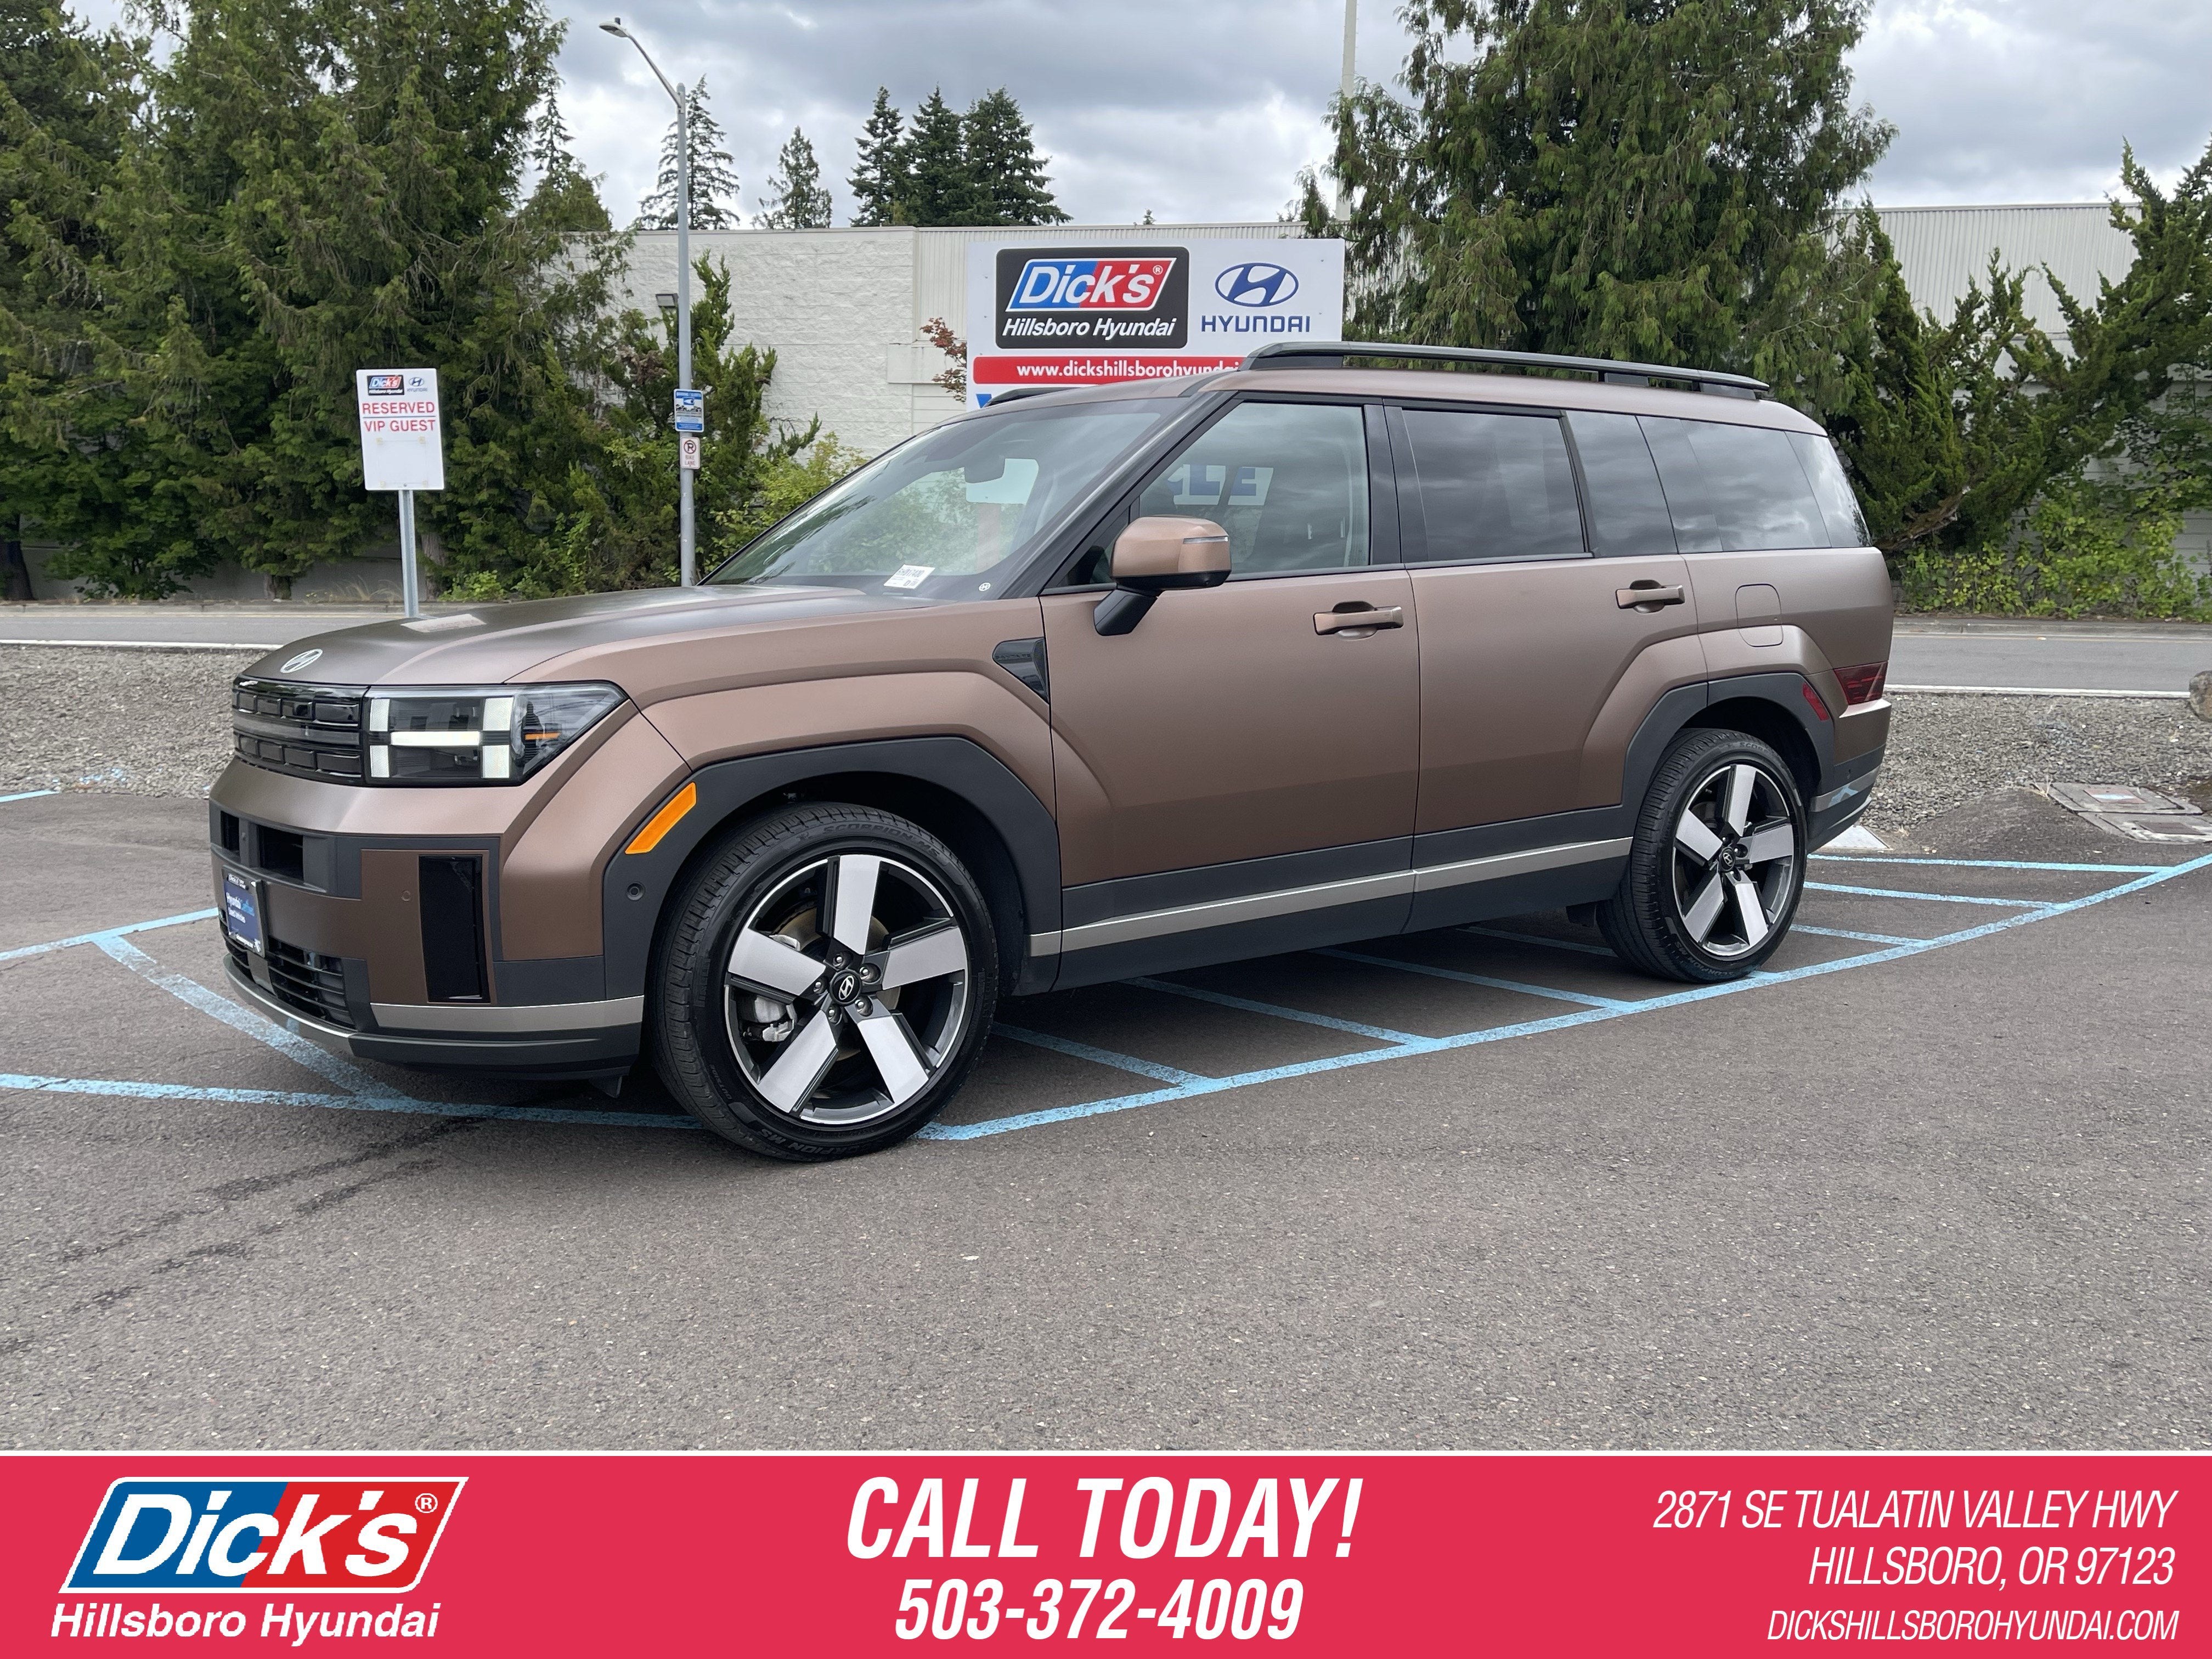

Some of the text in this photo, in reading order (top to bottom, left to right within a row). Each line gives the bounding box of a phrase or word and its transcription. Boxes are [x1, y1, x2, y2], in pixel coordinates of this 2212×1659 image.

[1002, 318, 1177, 341] Hillsboro Hyundai
[1200, 315, 1311, 332] HYUNDAI
[362, 402, 435, 414] RESERVED
[364, 420, 436, 432] VIP GUEST
